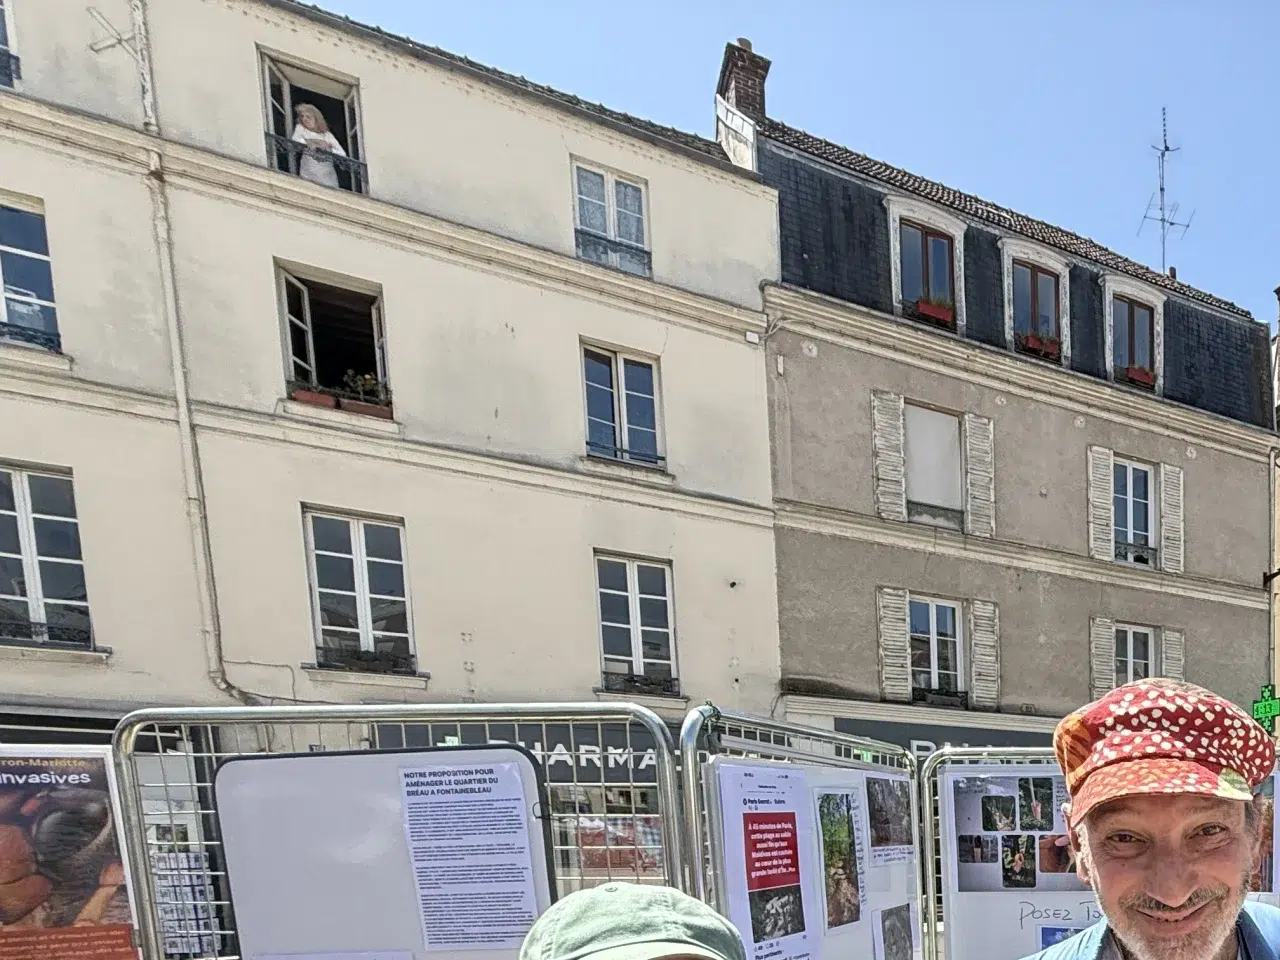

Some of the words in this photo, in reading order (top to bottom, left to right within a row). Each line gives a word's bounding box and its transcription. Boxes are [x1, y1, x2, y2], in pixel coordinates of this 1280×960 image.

[404, 771, 427, 779] NOTRE
[428, 769, 474, 778] PROPOSITION
[405, 779, 444, 788] AMÉNAGER
[454, 777, 488, 786] QUARTIER
[406, 788, 430, 796] BRÉAU
[436, 787, 492, 795] FONTAINEBLEAU
[1019, 901, 1073, 930] POSEZ
